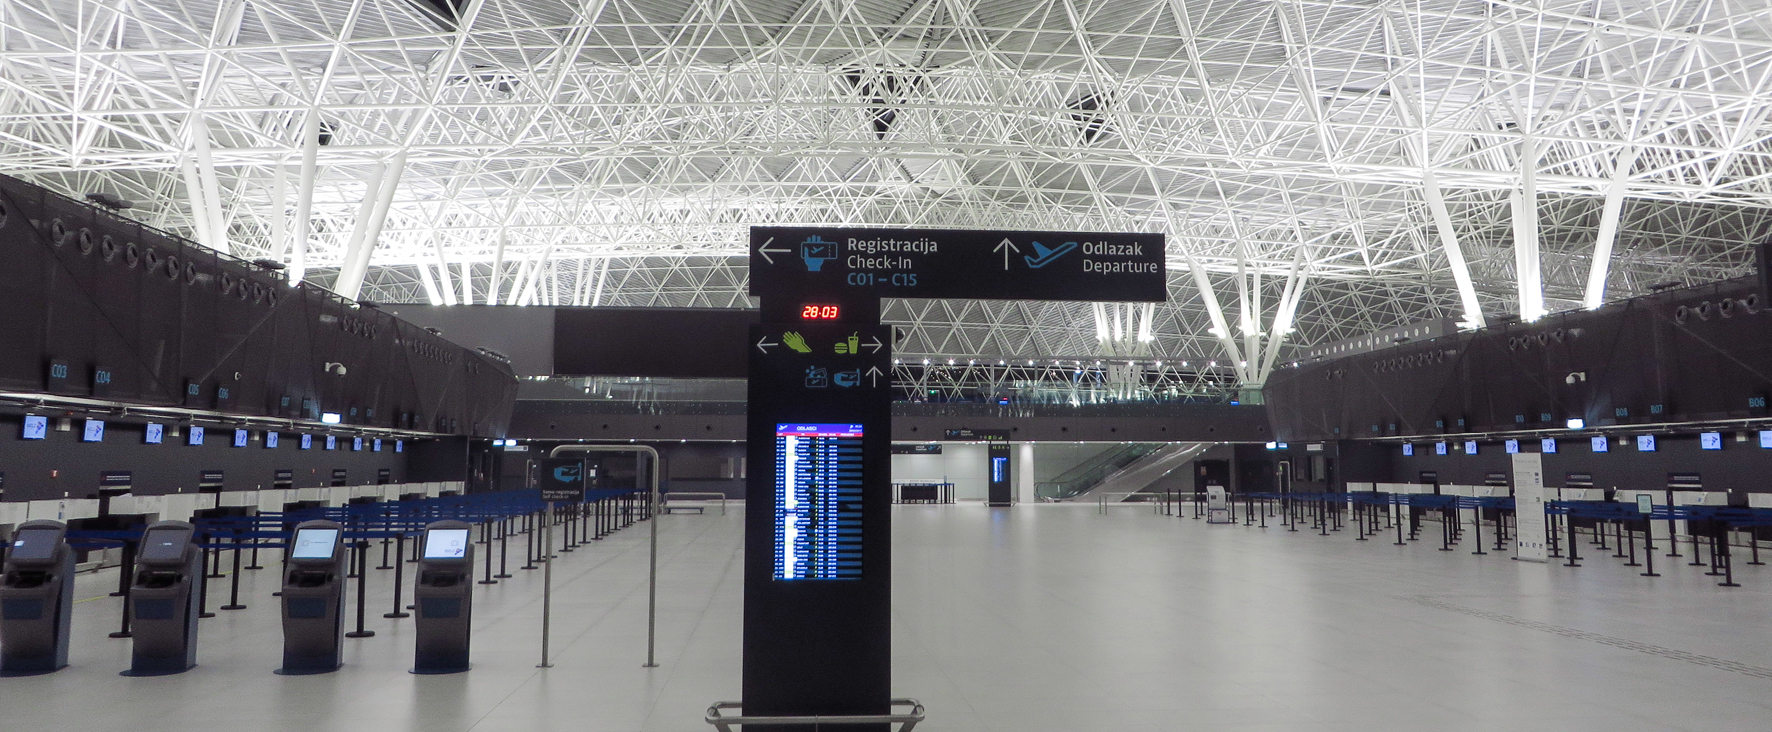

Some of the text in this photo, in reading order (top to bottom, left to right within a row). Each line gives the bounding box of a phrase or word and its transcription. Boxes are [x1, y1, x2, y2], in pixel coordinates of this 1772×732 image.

[847, 237, 938, 254] Registracija
[1082, 241, 1143, 256] Odlazak
[847, 254, 912, 269] Check-In
[1083, 259, 1158, 275] Departure
[847, 272, 874, 286] C01
[892, 273, 918, 286] C15
[52, 364, 67, 378] C03
[96, 370, 110, 384] C04
[1650, 404, 1663, 414] B07
[1749, 397, 1765, 408] B06
